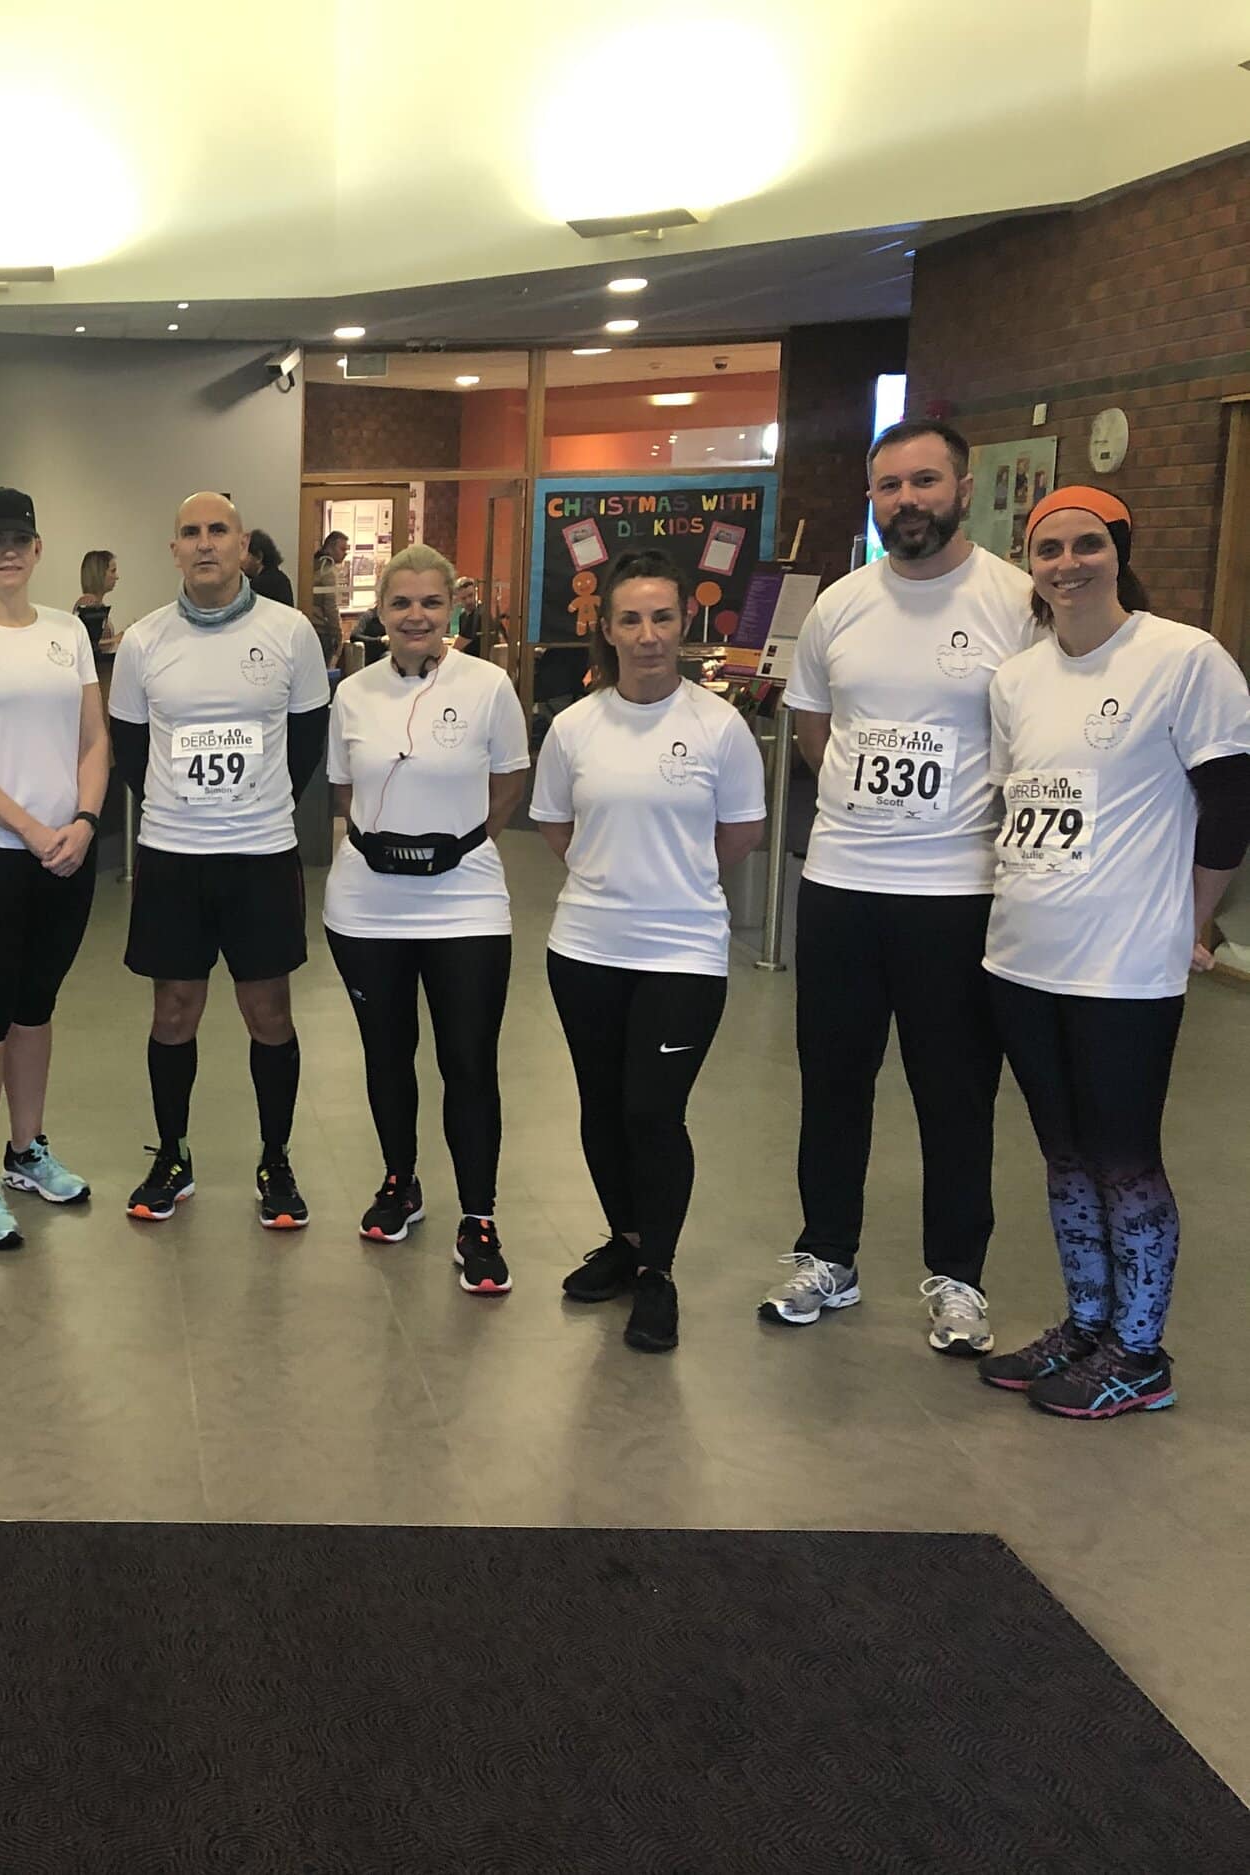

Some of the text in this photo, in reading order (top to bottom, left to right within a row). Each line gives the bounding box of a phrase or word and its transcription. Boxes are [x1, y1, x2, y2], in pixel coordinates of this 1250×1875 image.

[547, 492, 756, 518] CHRISTMAS WITH
[654, 517, 704, 536] KIDS
[223, 736, 253, 745] mile
[913, 731, 931, 742] 10
[907, 740, 943, 752] mile
[188, 752, 245, 786] 459
[853, 753, 942, 800] 1330
[1053, 778, 1068, 789] 10
[1048, 787, 1082, 799] mile
[876, 796, 940, 810] Scott L
[1003, 808, 1083, 849] 1979
